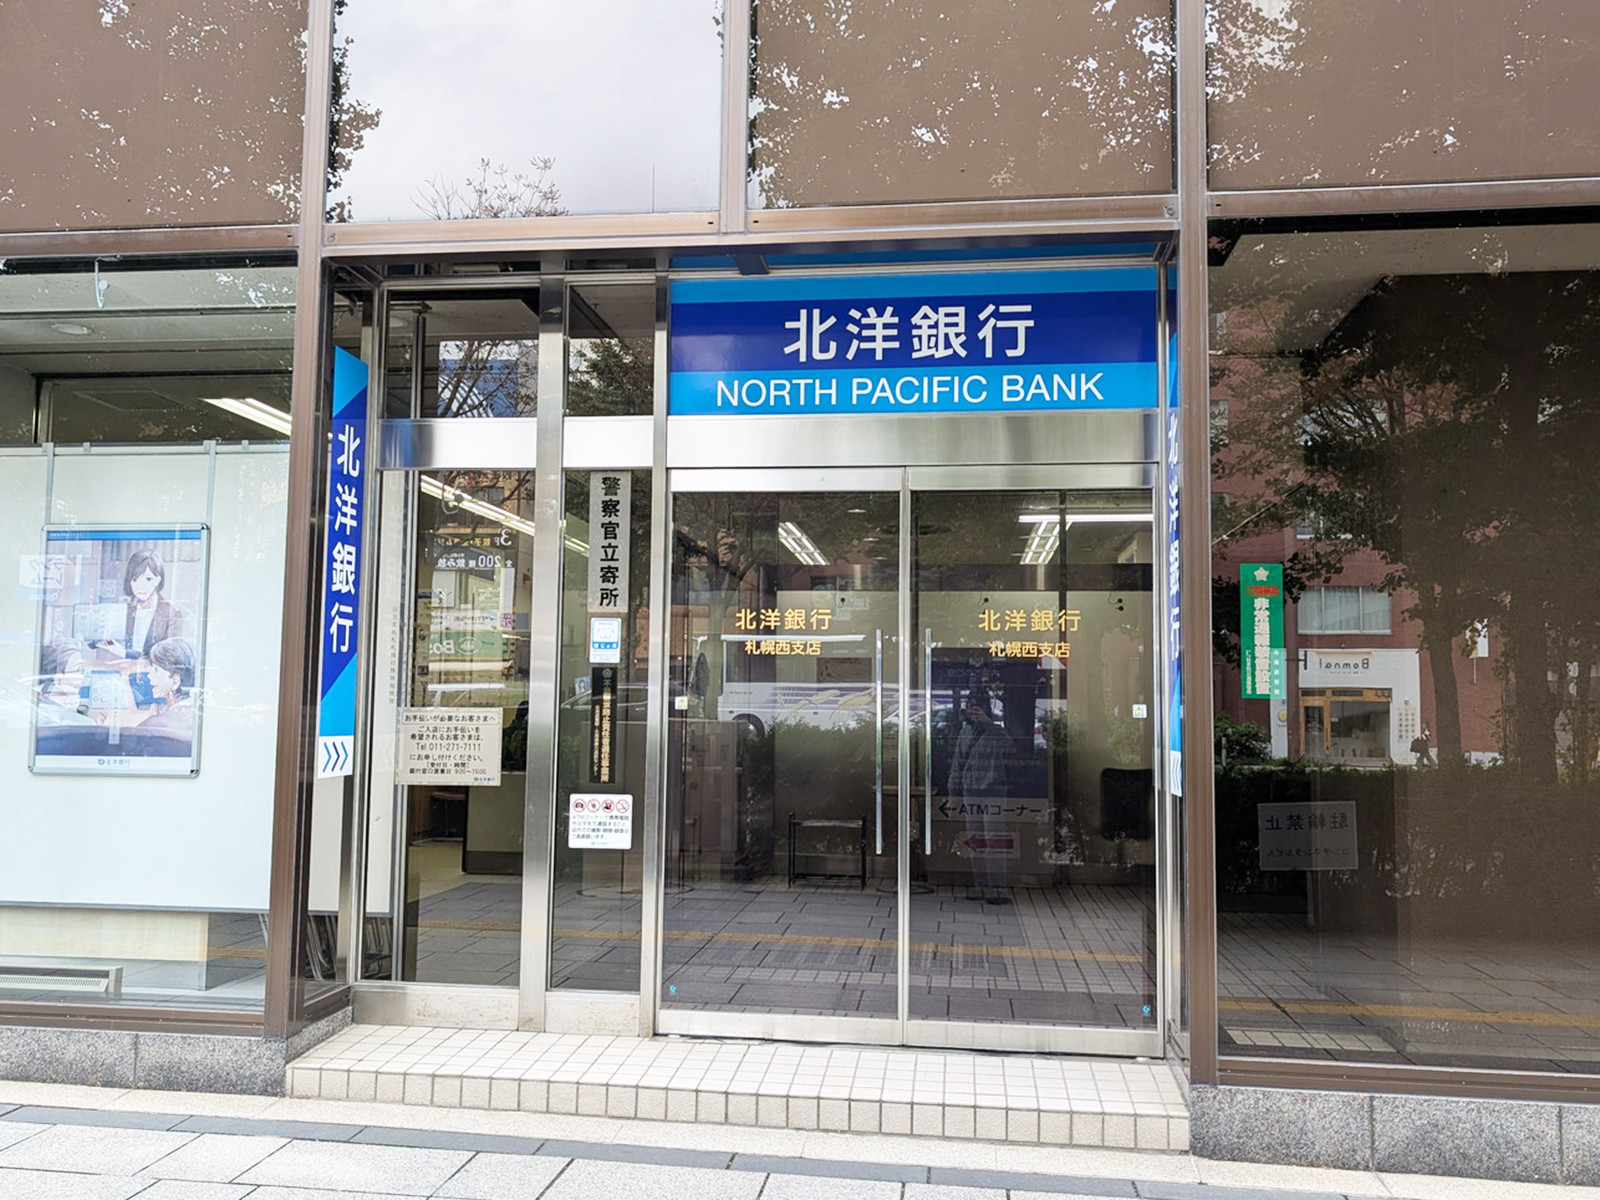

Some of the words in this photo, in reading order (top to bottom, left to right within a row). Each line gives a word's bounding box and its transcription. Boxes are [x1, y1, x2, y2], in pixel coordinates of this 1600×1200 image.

[783, 303, 1036, 363] 北洋銀行
[716, 379, 838, 408] NORTH
[852, 375, 988, 405] PACIFIC
[1003, 371, 1105, 402] BANK
[329, 423, 361, 655] 北洋銀行
[599, 476, 621, 608] 警察官立寄所
[735, 608, 832, 631] 北洋銀行
[977, 608, 1081, 633] 北洋銀行
[744, 640, 822, 656] 札幌西支店
[989, 641, 1071, 658] 札幌西支店
[428, 743, 481, 751] 011-271-7111
[958, 803, 1042, 817] ATMコーナー
